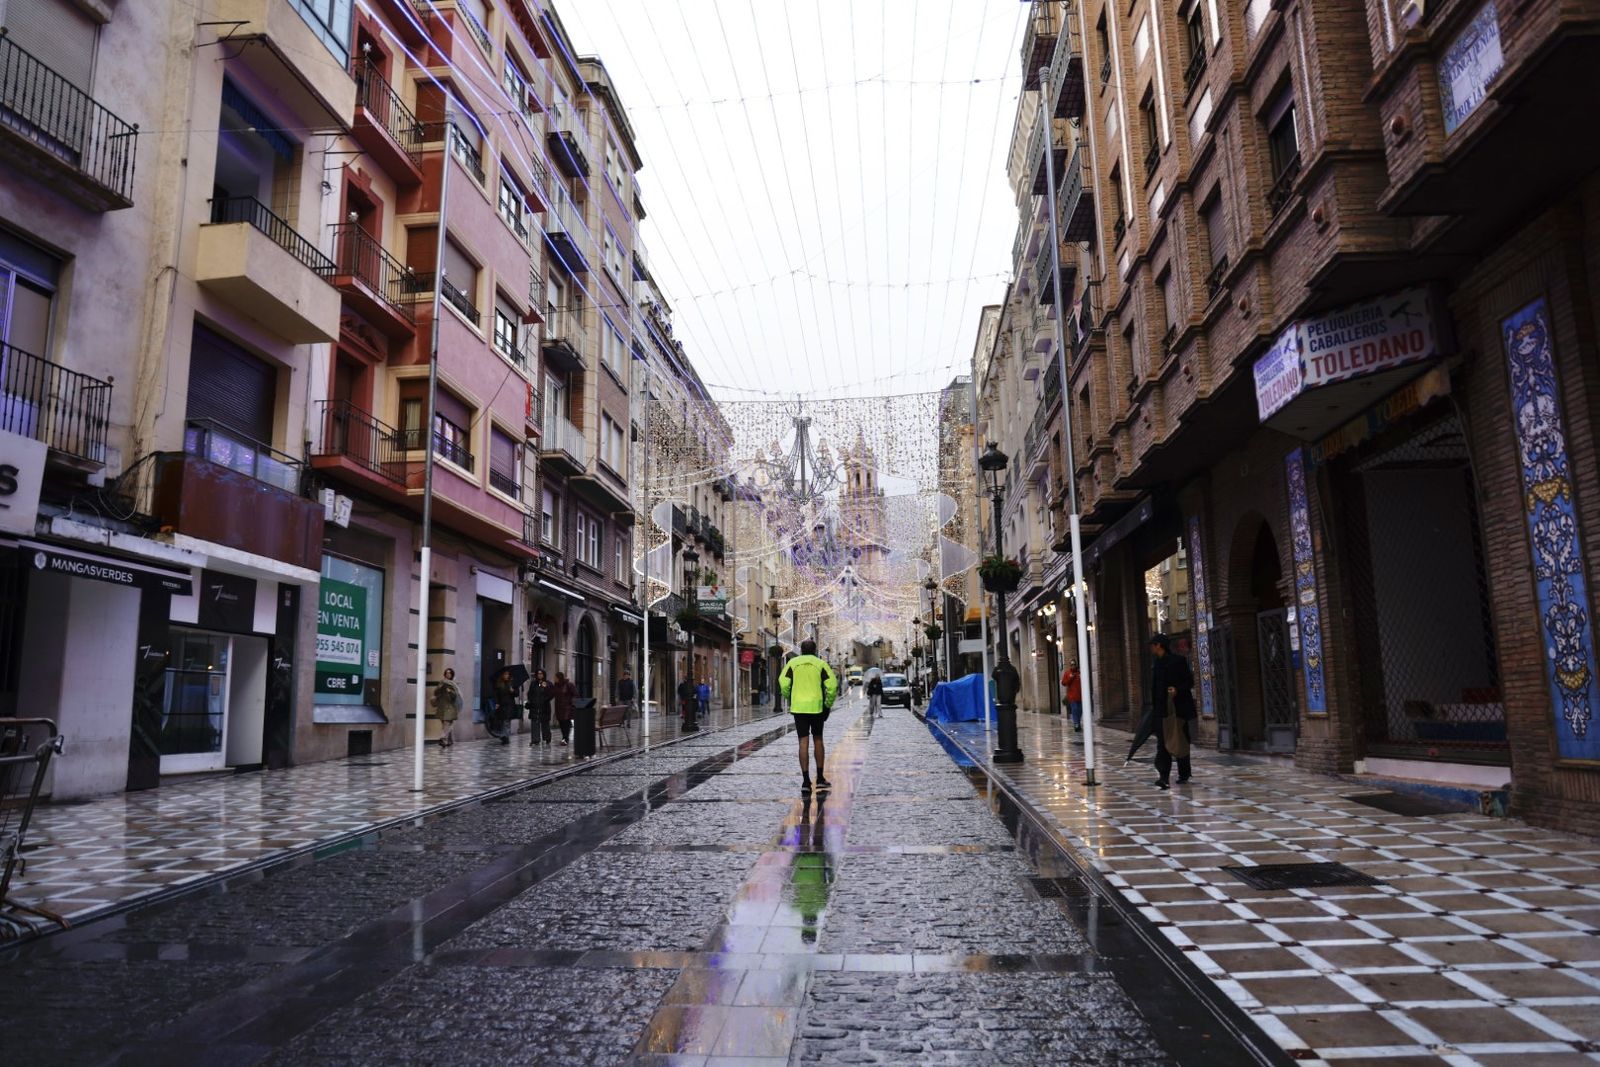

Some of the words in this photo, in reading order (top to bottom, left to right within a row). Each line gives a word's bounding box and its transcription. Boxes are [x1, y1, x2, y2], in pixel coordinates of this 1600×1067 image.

[1307, 304, 1385, 338] PELUQUERIA
[1309, 319, 1388, 353] CABALLEROS
[1311, 329, 1425, 379] TOLEDANO
[1260, 367, 1299, 412] TOLEDANO
[51, 557, 133, 583] MANGASVERDES
[325, 591, 354, 610] LOCAL
[332, 612, 360, 630] VENTA
[331, 640, 344, 653] 545
[346, 642, 359, 655] 074
[327, 677, 346, 689] CBRE
